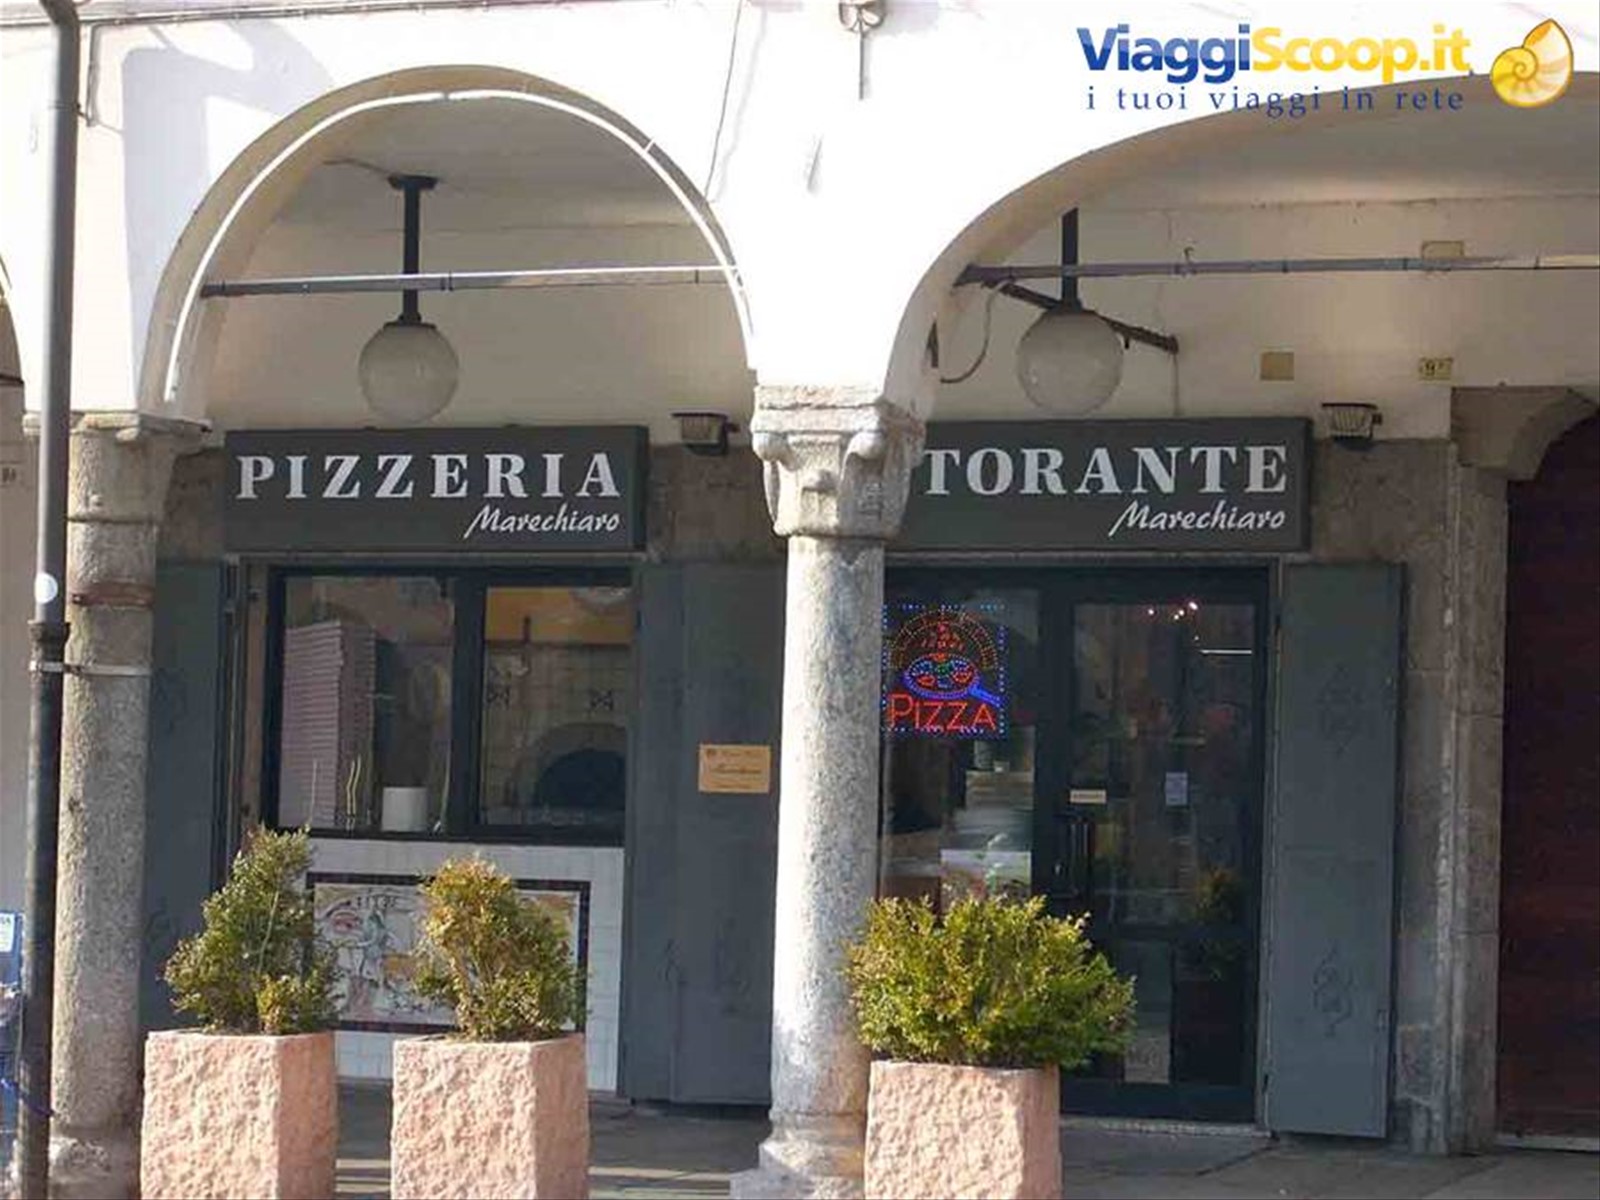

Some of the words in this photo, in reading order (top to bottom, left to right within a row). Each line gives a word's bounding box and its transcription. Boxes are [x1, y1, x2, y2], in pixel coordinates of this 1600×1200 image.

[236, 453, 621, 500] PIZZERIA
[924, 445, 1288, 495] TORANTE
[463, 504, 621, 540] Marechiaro
[1108, 500, 1286, 537] Marechiaro
[889, 693, 997, 732] PIZZA
